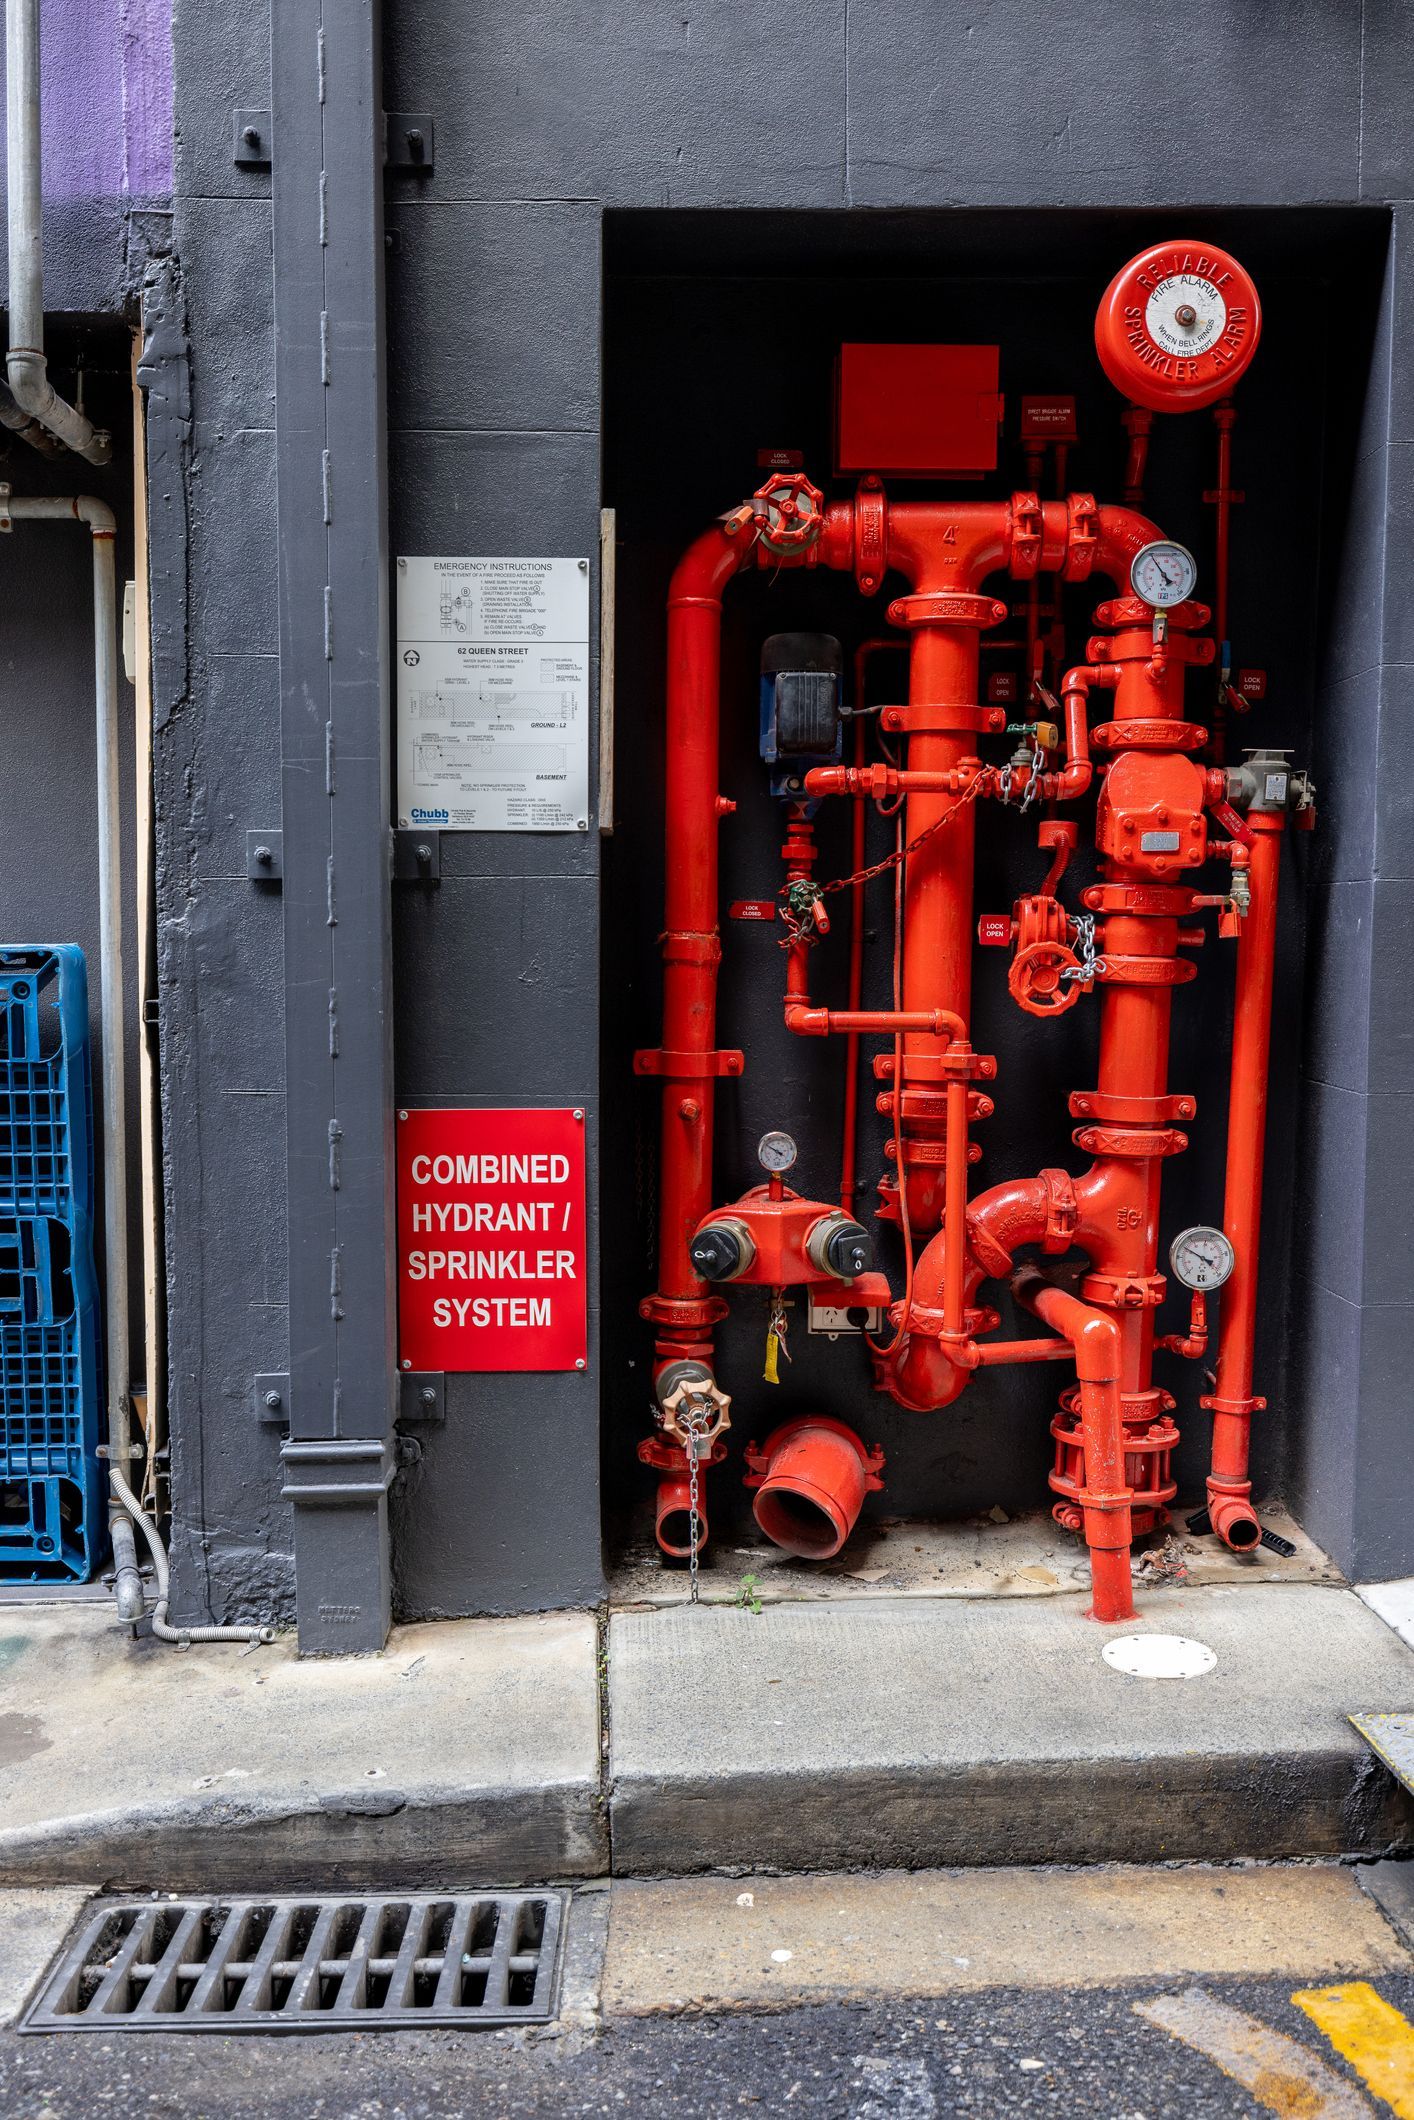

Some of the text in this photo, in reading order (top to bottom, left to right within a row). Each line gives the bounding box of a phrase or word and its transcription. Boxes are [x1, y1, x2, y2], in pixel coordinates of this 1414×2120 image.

[1136, 254, 1234, 290] RELIABLE
[1151, 275, 1219, 303] FIRE ALARM
[1124, 306, 1248, 380] SPRINKLER ALARM
[1158, 318, 1215, 348] WHEN BELL RINGS
[1158, 340, 1175, 355] CALL
[1177, 349, 1195, 357] FIRE
[434, 562, 553, 571] EMERGENCY INSTRUCTIONS
[411, 808, 449, 818] Chubb
[412, 1154, 570, 1184] COMBINED
[412, 1202, 572, 1232] HYDRANT /
[408, 1250, 577, 1280] SPRINKLER
[433, 1298, 552, 1328] SYSTEM
